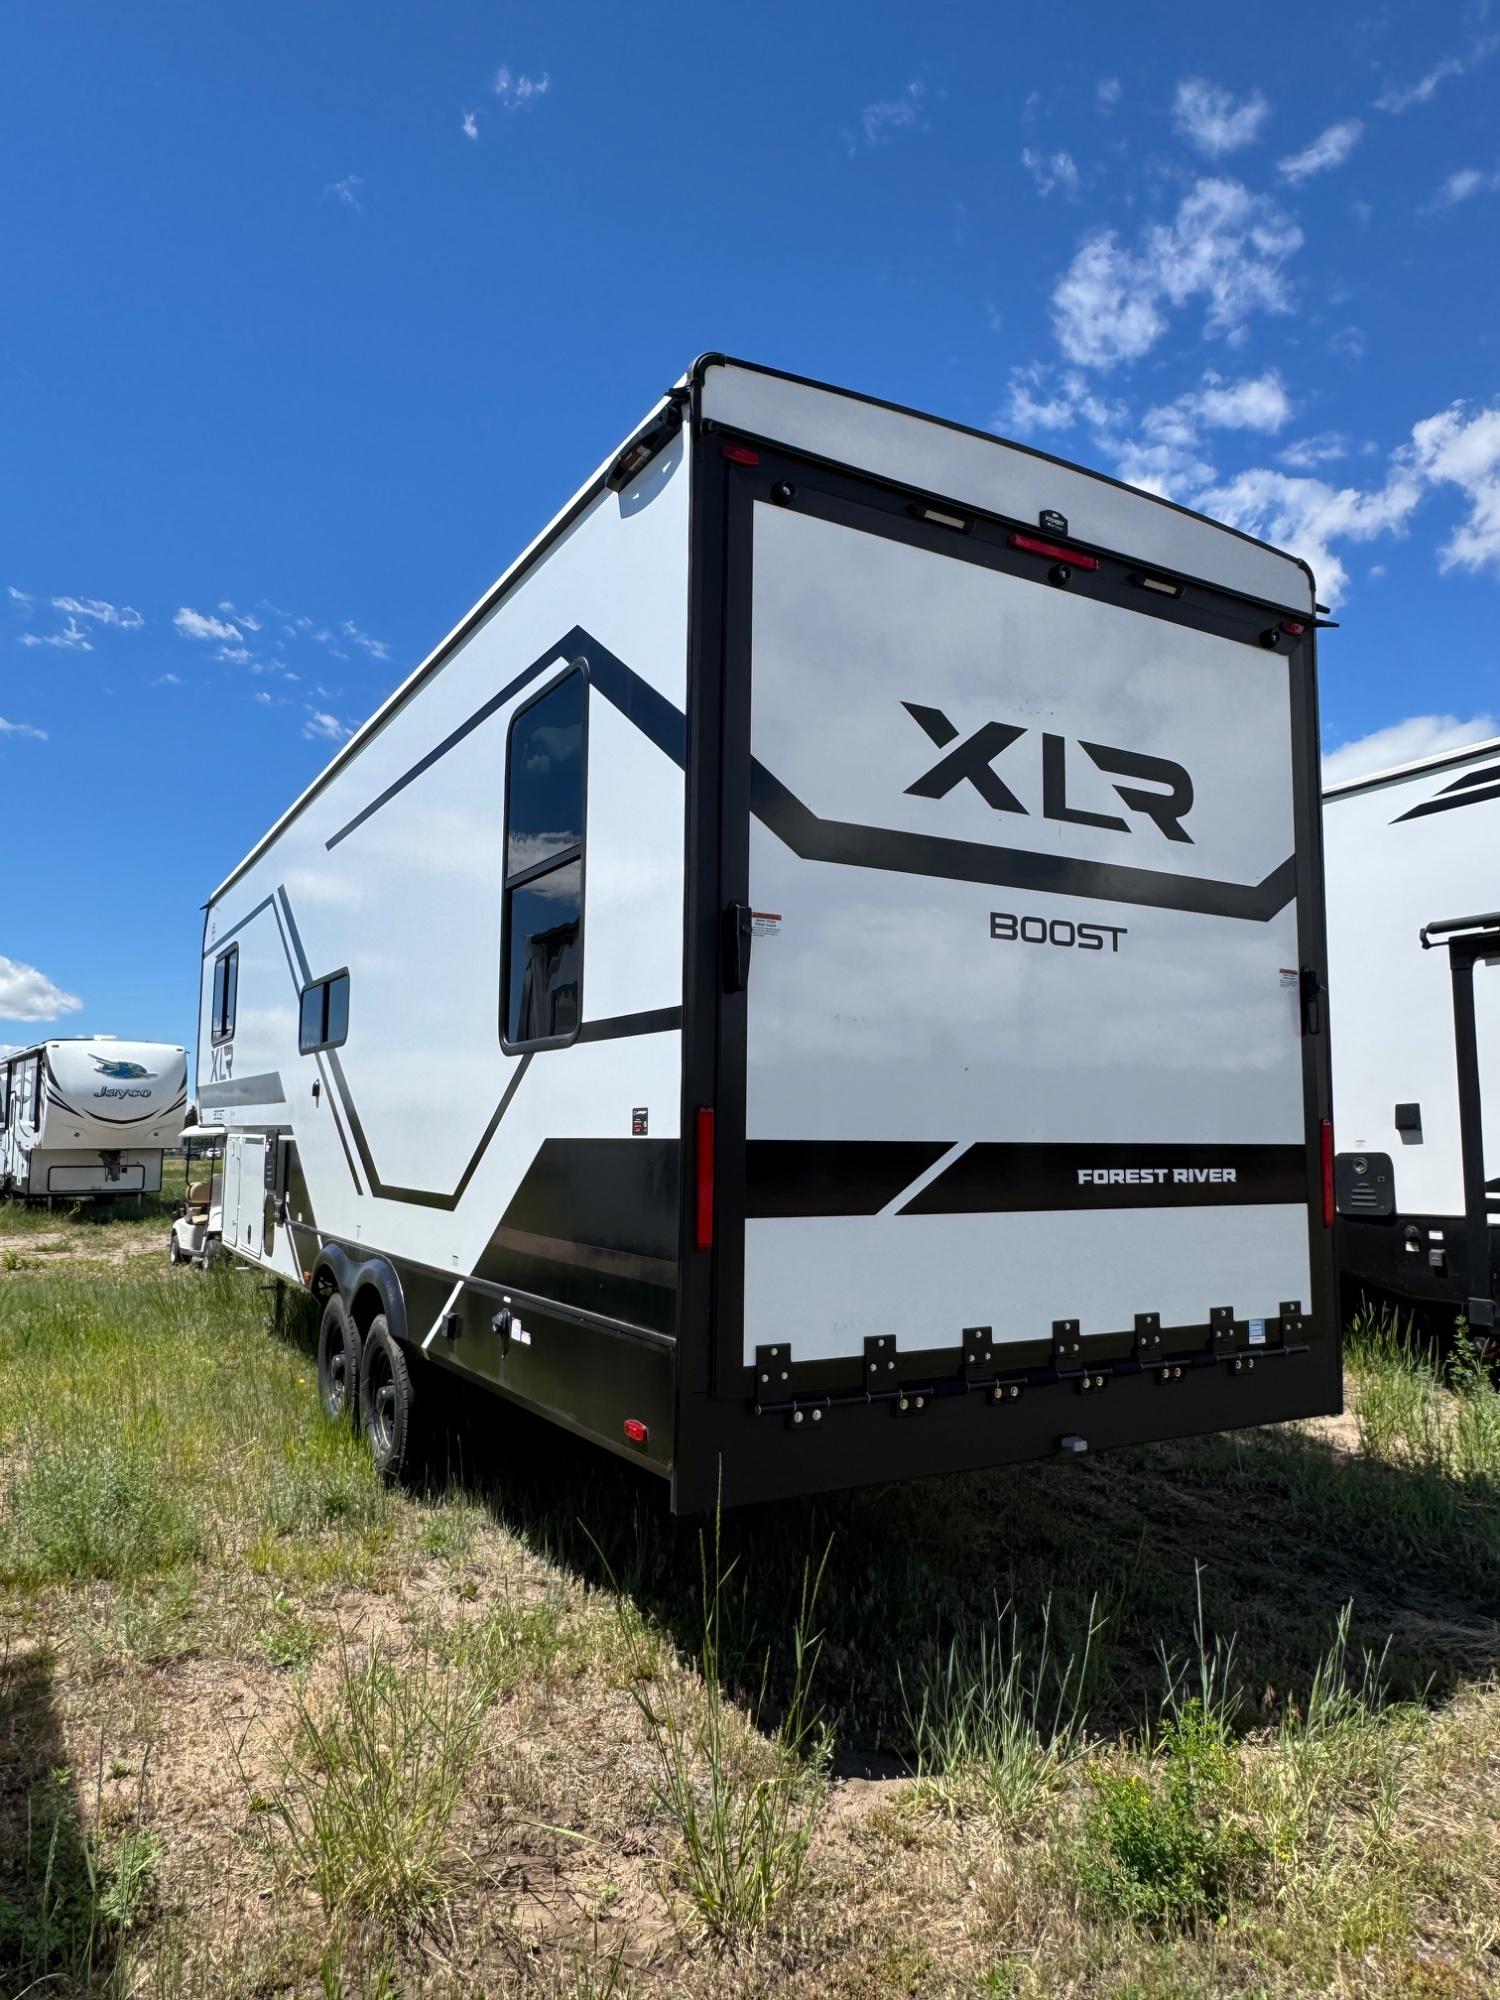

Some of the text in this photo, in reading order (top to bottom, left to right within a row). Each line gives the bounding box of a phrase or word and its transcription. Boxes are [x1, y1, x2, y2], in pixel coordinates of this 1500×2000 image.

[899, 700, 1195, 845] XLR
[990, 911, 1128, 952] BOOST
[210, 1043, 233, 1083] XLR
[93, 1086, 152, 1100] Jayco
[1077, 1168, 1237, 1184] FOREST RIVER
